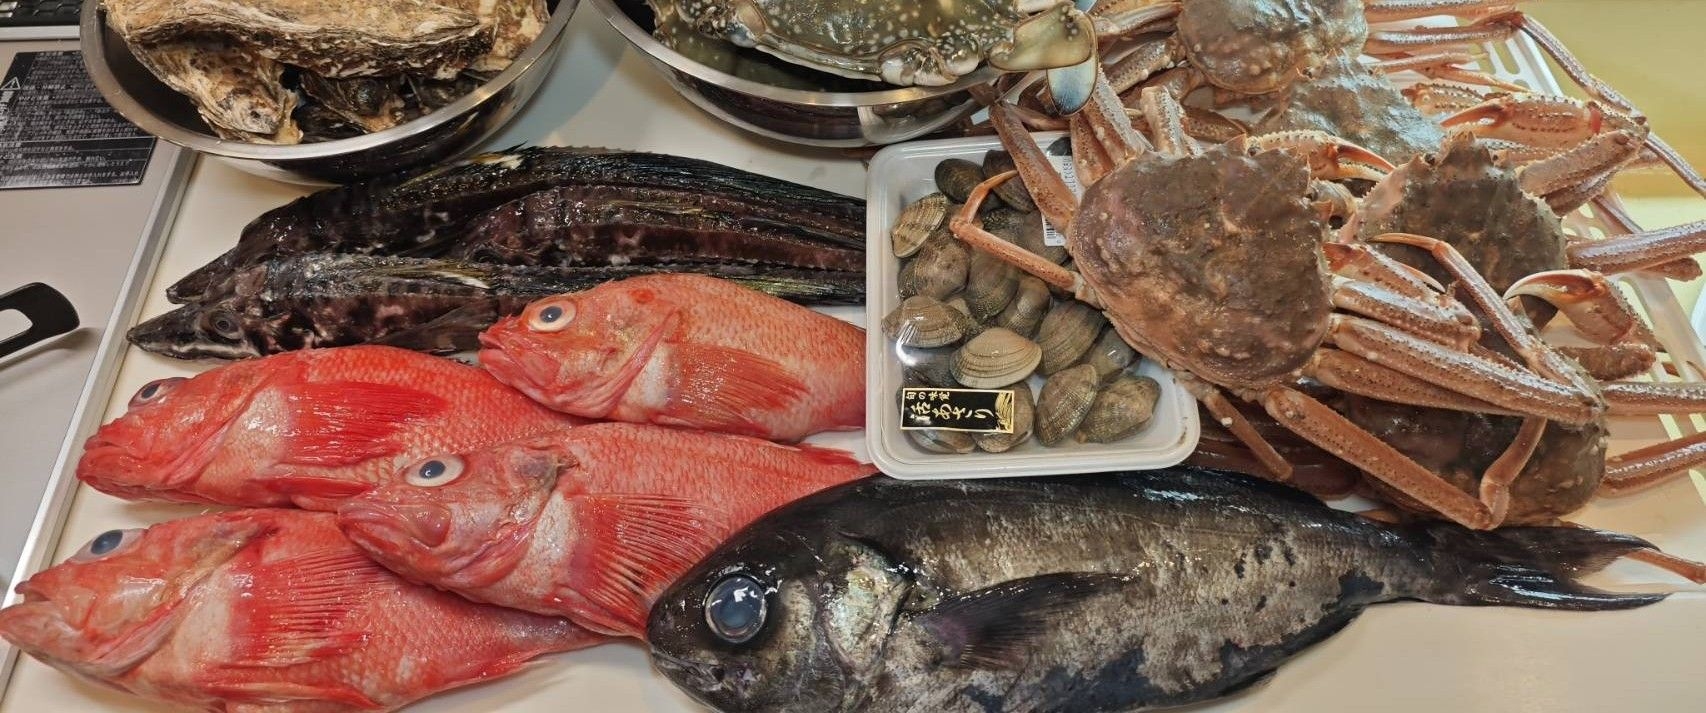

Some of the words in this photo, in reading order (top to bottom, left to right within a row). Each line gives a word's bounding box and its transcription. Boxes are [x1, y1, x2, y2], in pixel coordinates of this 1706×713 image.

[906, 391, 950, 401] 旬の味覚
[909, 401, 994, 425] 活あさり
